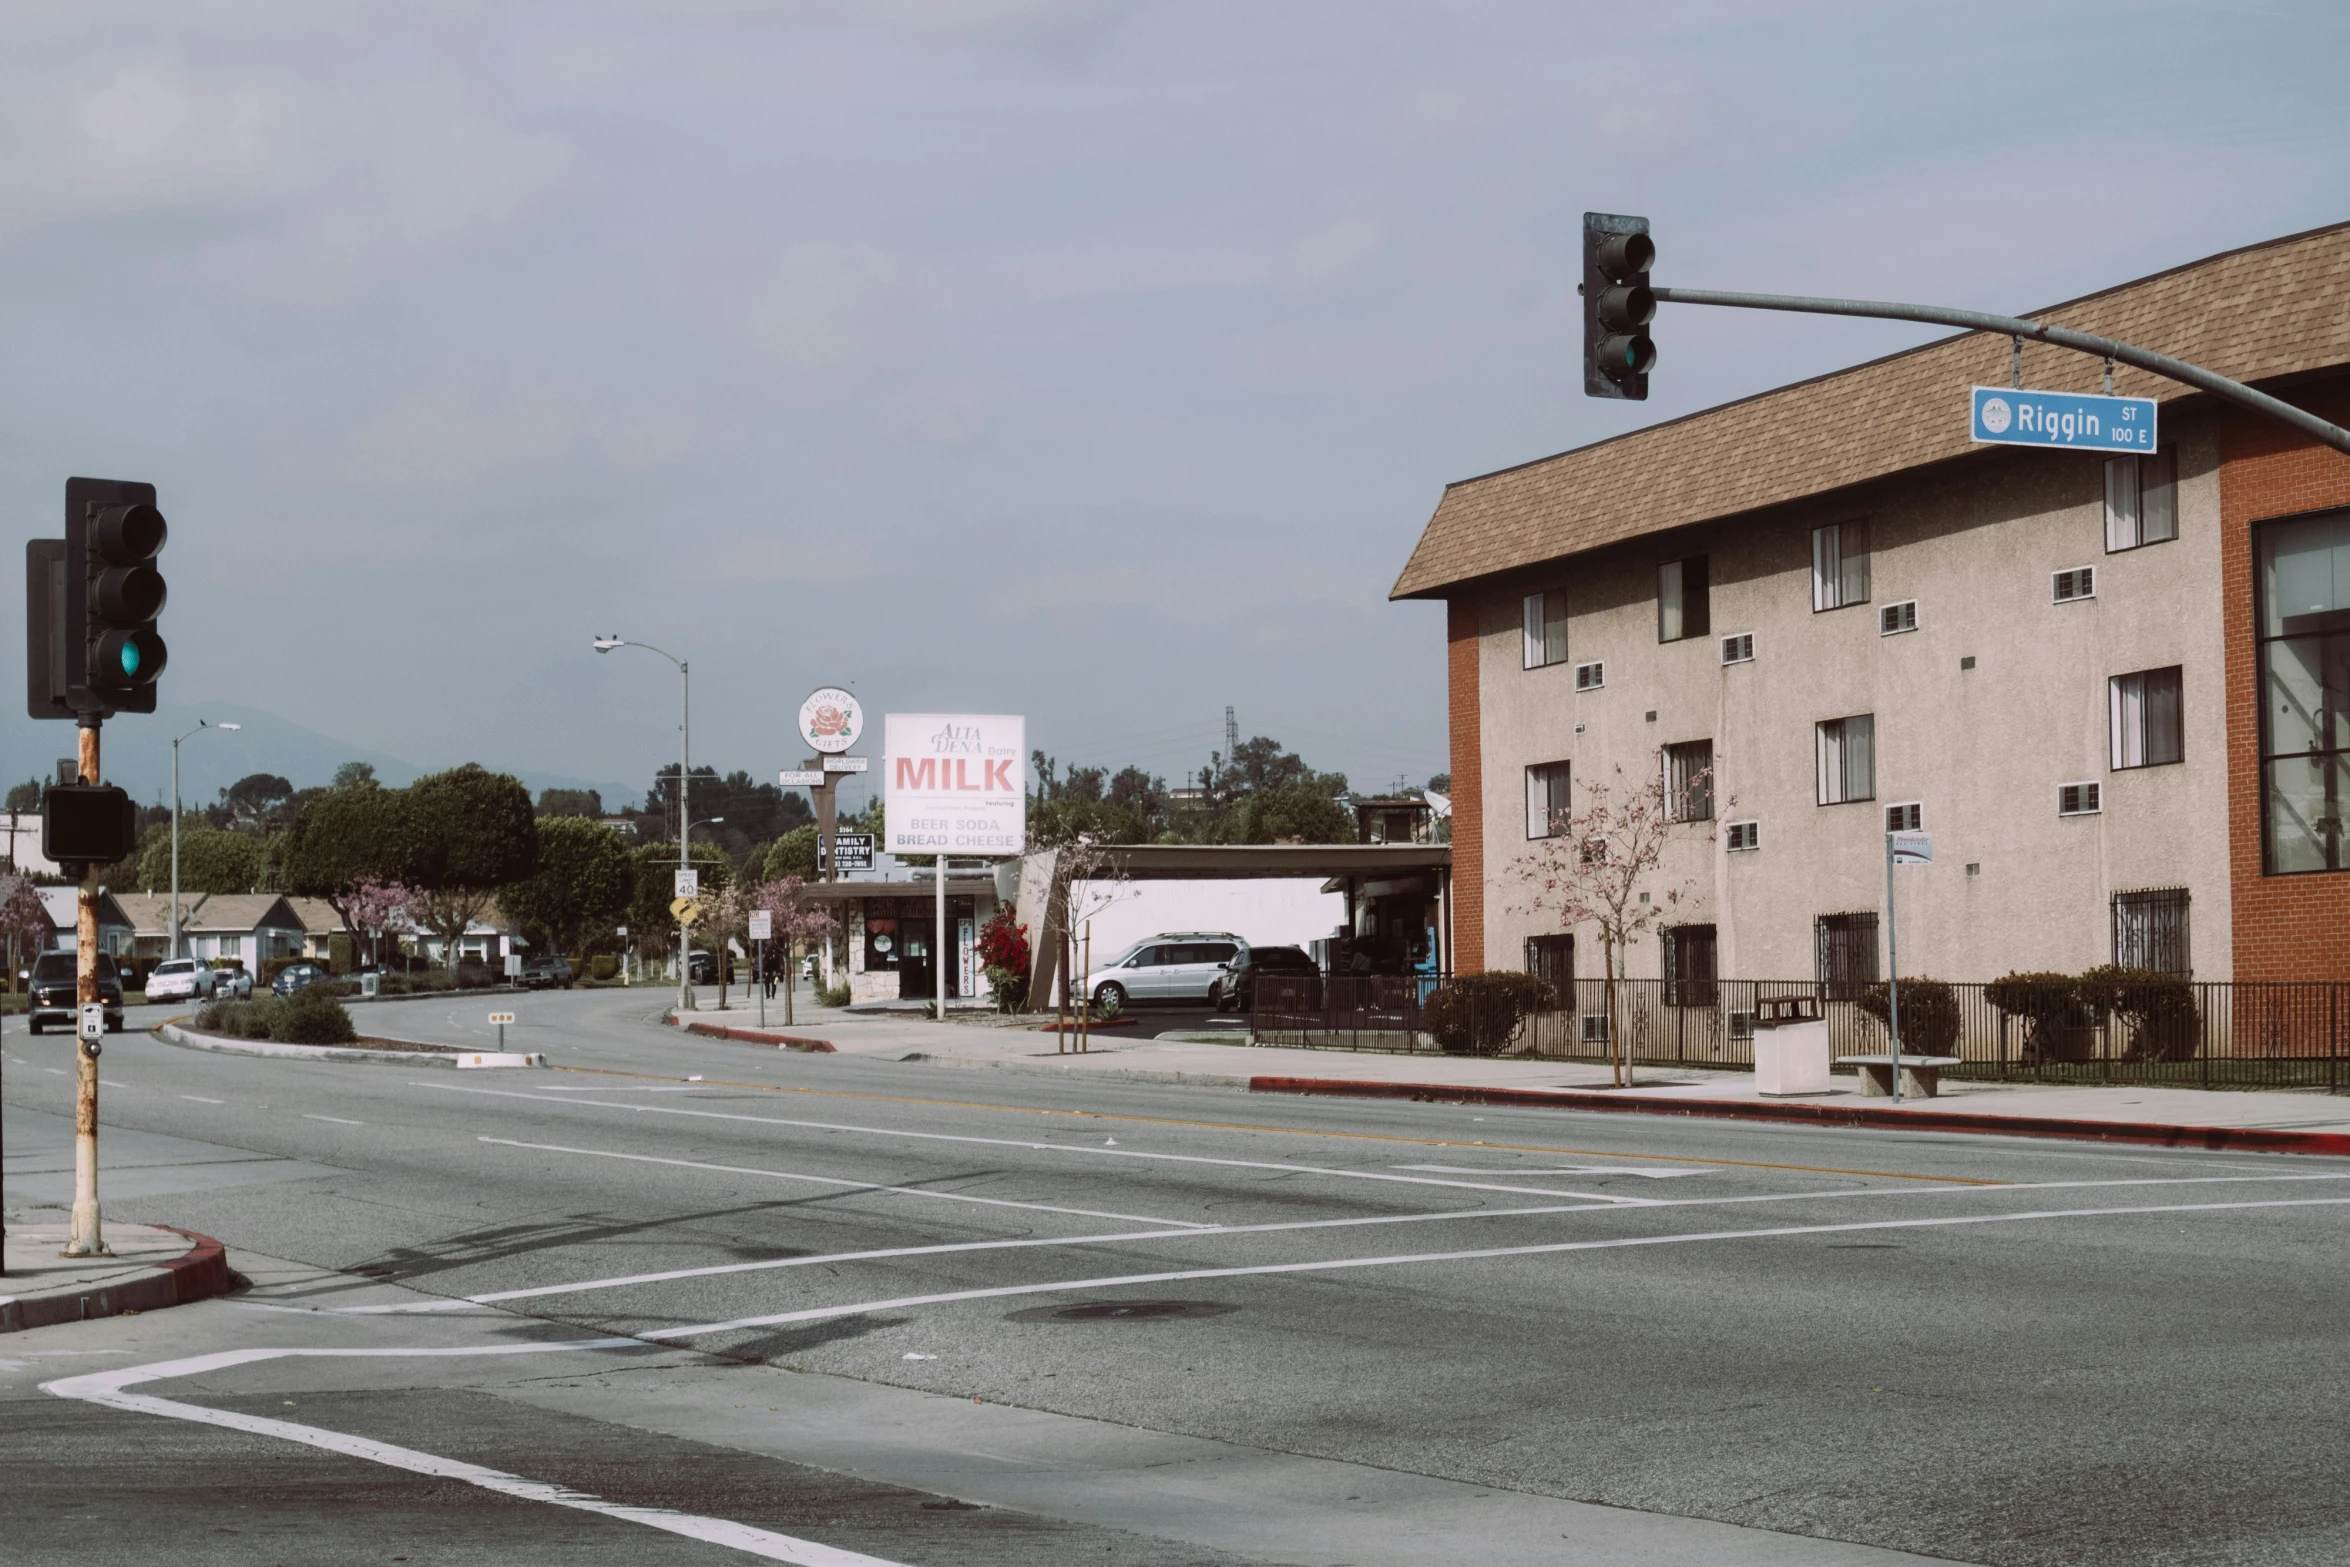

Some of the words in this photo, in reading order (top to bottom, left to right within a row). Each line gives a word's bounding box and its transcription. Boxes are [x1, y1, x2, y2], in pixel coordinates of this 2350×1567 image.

[2122, 406, 2138, 421] ST
[2018, 404, 2100, 443] Riggin
[2111, 428, 2133, 443] 100
[2139, 429, 2147, 443] E
[805, 692, 855, 712] FLOWERS
[815, 738, 848, 748] GIFTS
[988, 746, 1017, 757] Dairy
[896, 757, 1016, 792] MILK
[985, 800, 1015, 808] Featuring
[910, 819, 949, 830] BEER
[956, 819, 1000, 831] SODA
[897, 834, 948, 846] BREAD
[955, 835, 1015, 847] CHEESE
[820, 846, 870, 855] DNTISTRY
[679, 885, 695, 895] 40
